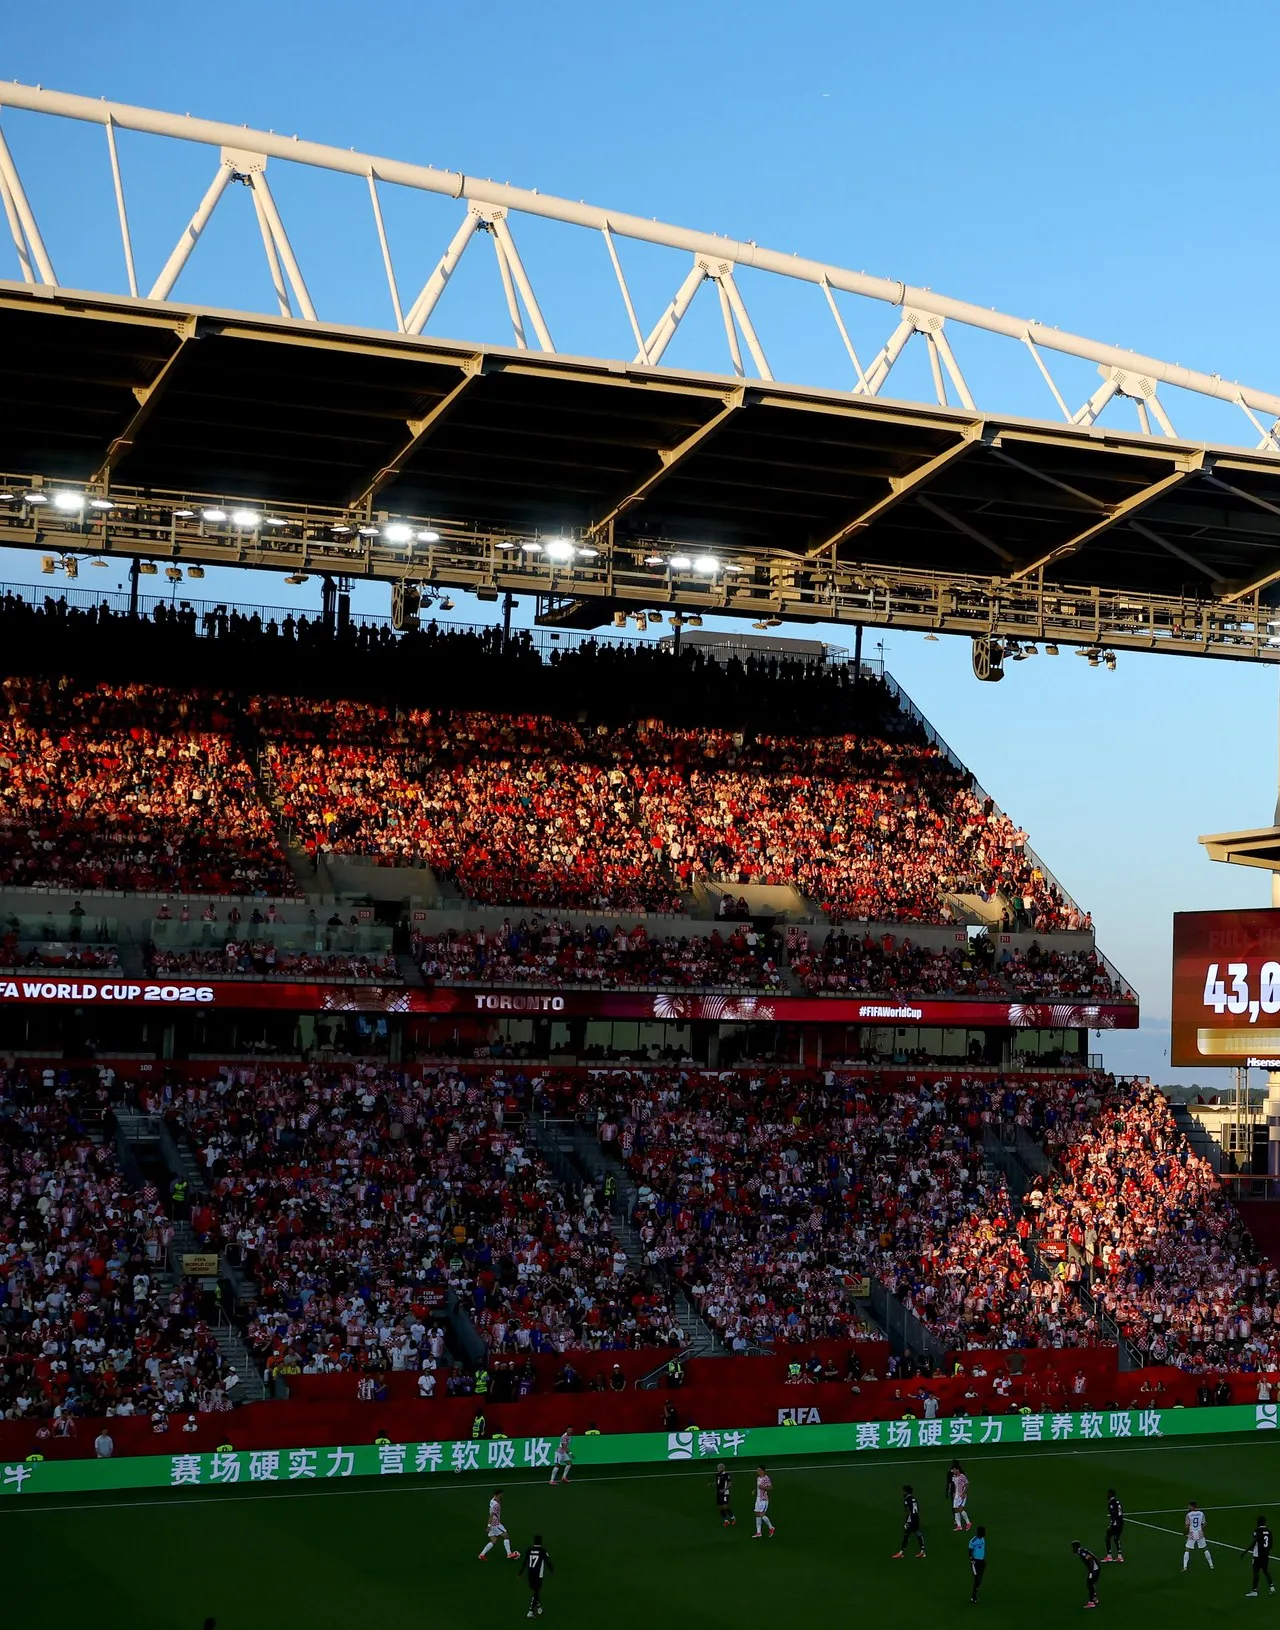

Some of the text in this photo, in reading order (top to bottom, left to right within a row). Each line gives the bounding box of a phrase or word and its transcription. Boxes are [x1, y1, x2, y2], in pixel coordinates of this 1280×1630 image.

[22, 982, 98, 999] WORLD
[100, 984, 141, 1000] CUP
[143, 985, 214, 1002] 2026
[475, 995, 564, 1011] TORONTO
[858, 1006, 922, 1020] #FIFAWorldCup
[1247, 1057, 1280, 1068] Hisense
[777, 1407, 821, 1425] FIFA
[856, 1409, 1163, 1451] 赛场硬实力 营养软吸收
[698, 1427, 747, 1457] 蒙牛
[170, 1436, 552, 1486] 赛场硬实力 营养软吸收
[1263, 1535, 1269, 1548] 3
[529, 1554, 540, 1568] 17
